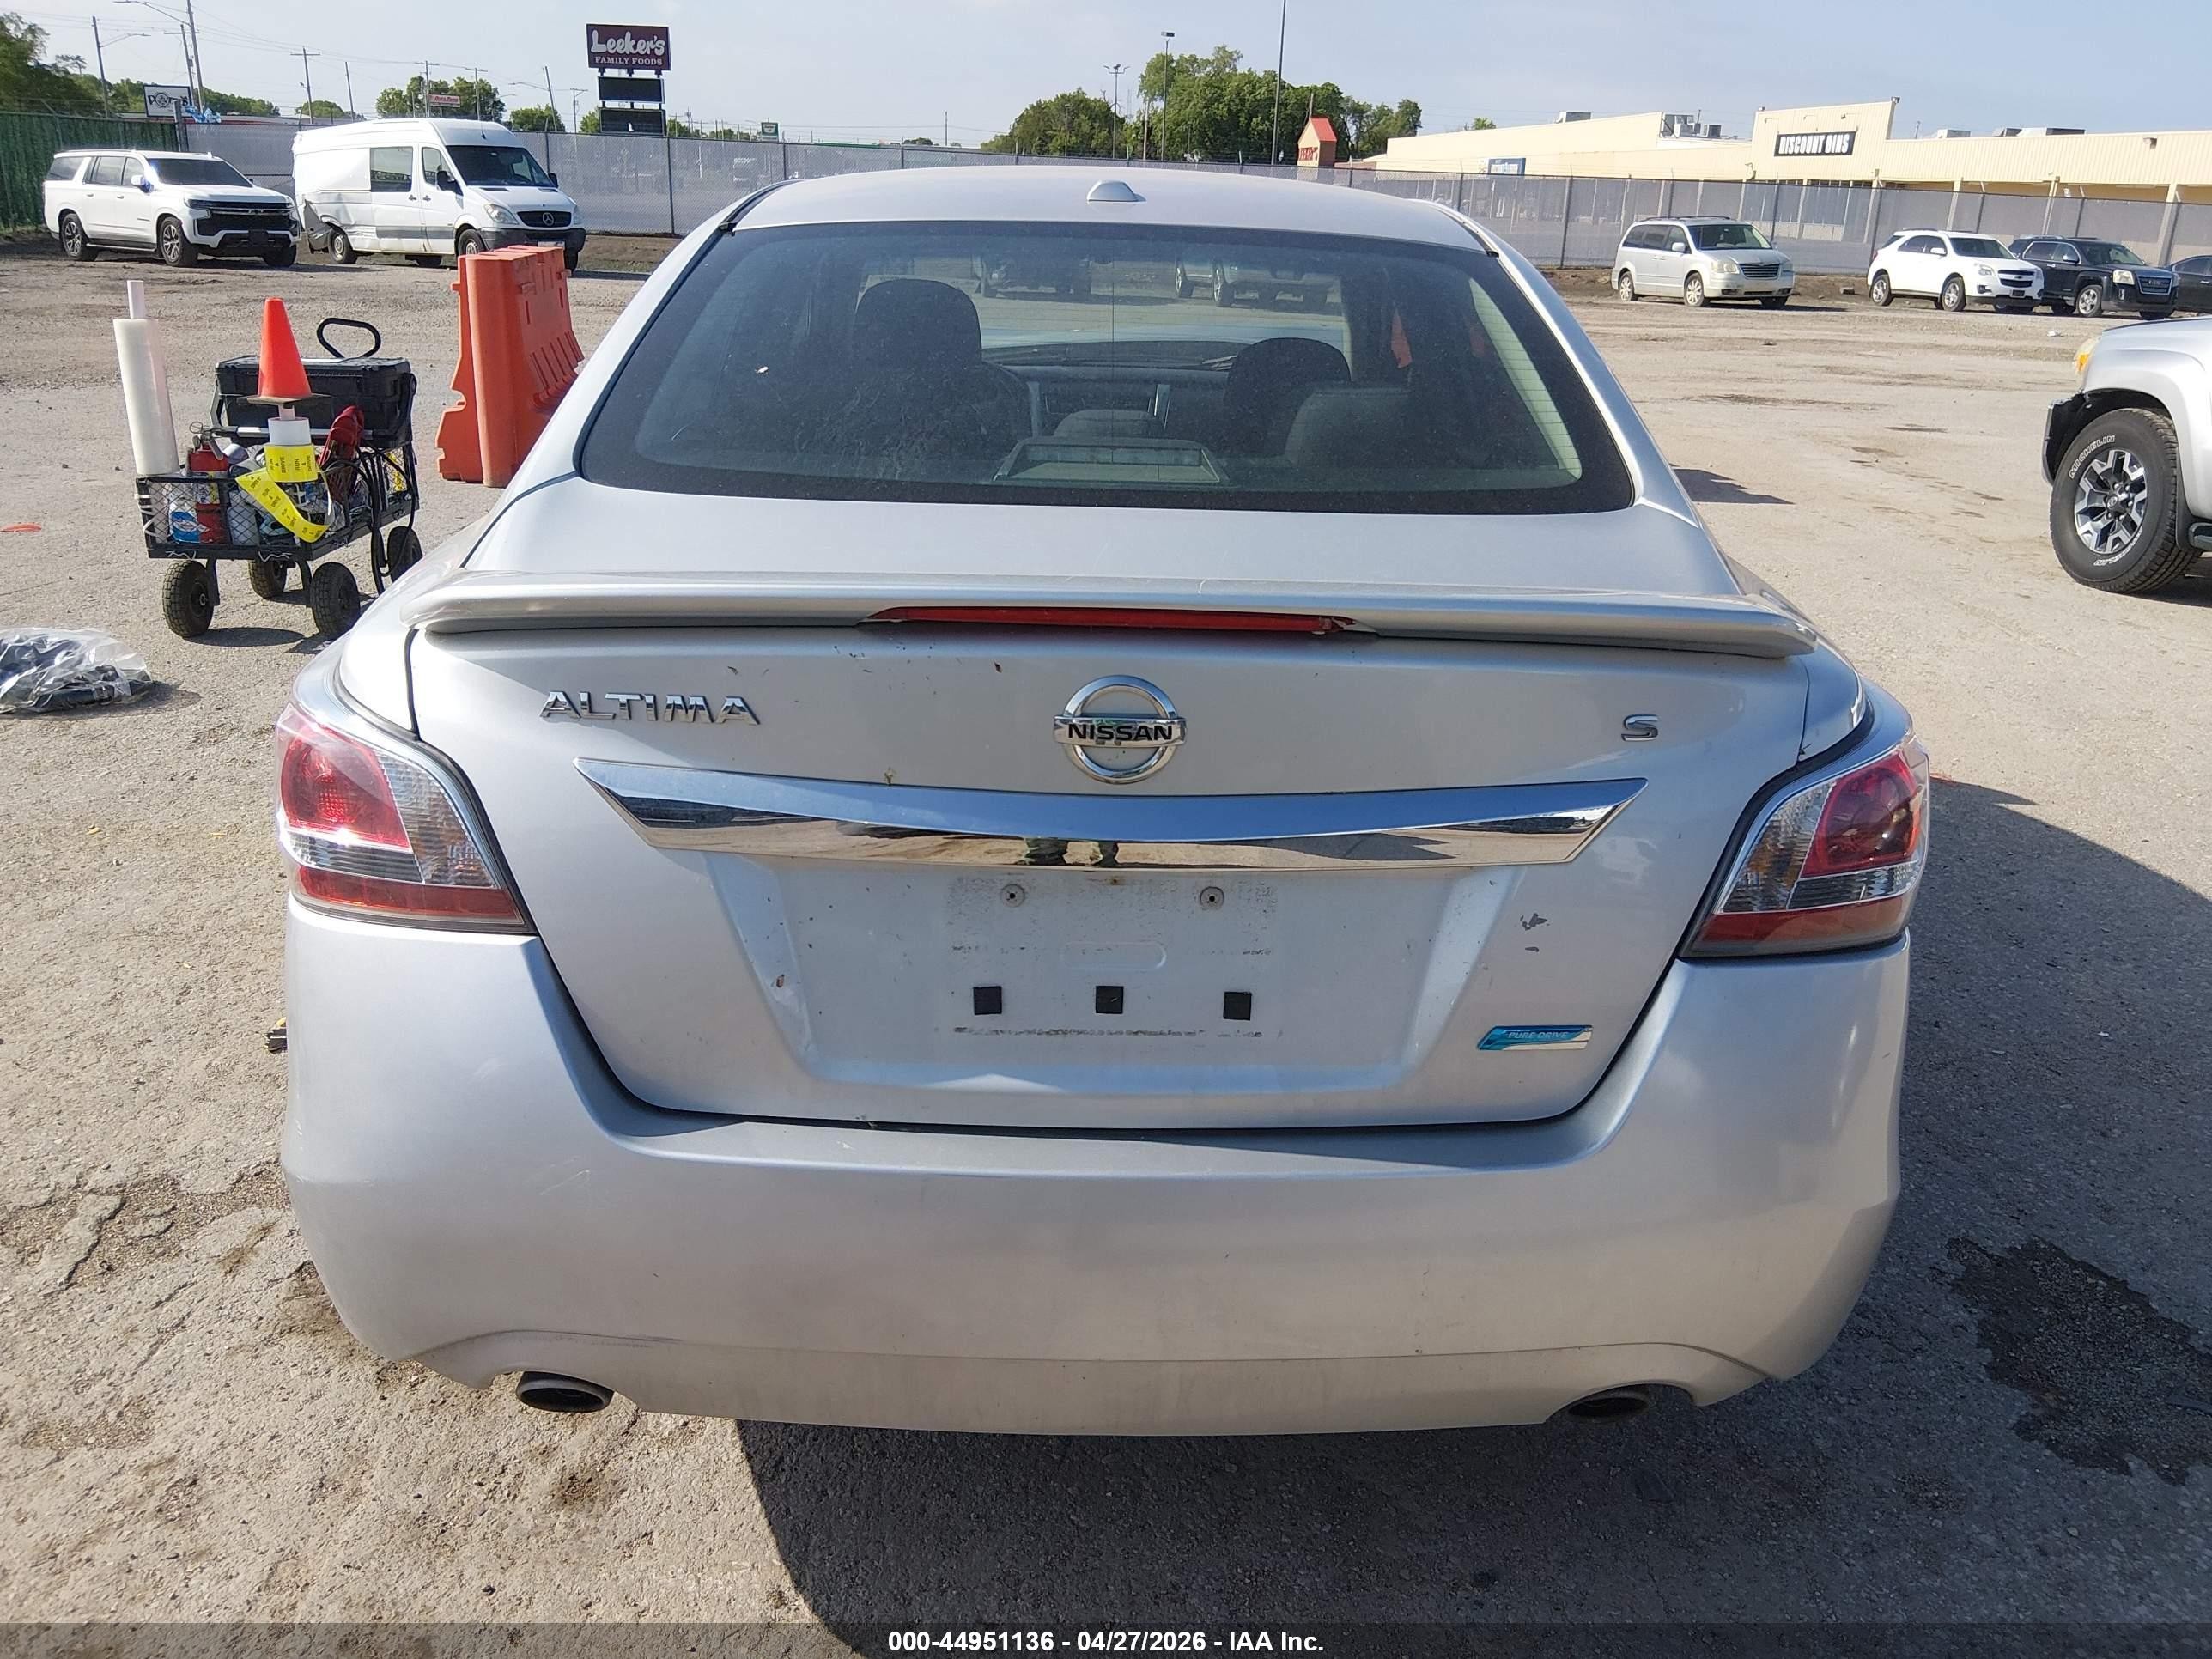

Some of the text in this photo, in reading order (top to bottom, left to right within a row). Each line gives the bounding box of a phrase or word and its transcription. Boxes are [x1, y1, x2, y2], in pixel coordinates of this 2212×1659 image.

[591, 29, 665, 56] Leeker's
[595, 56, 629, 64] FAMILY
[1778, 133, 1850, 155] DISCOUNT BINS
[2068, 434, 2115, 479] MICHELIN
[539, 690, 760, 725] ALTIMA
[1068, 724, 1172, 741] NISSAN
[1621, 714, 1658, 742] S
